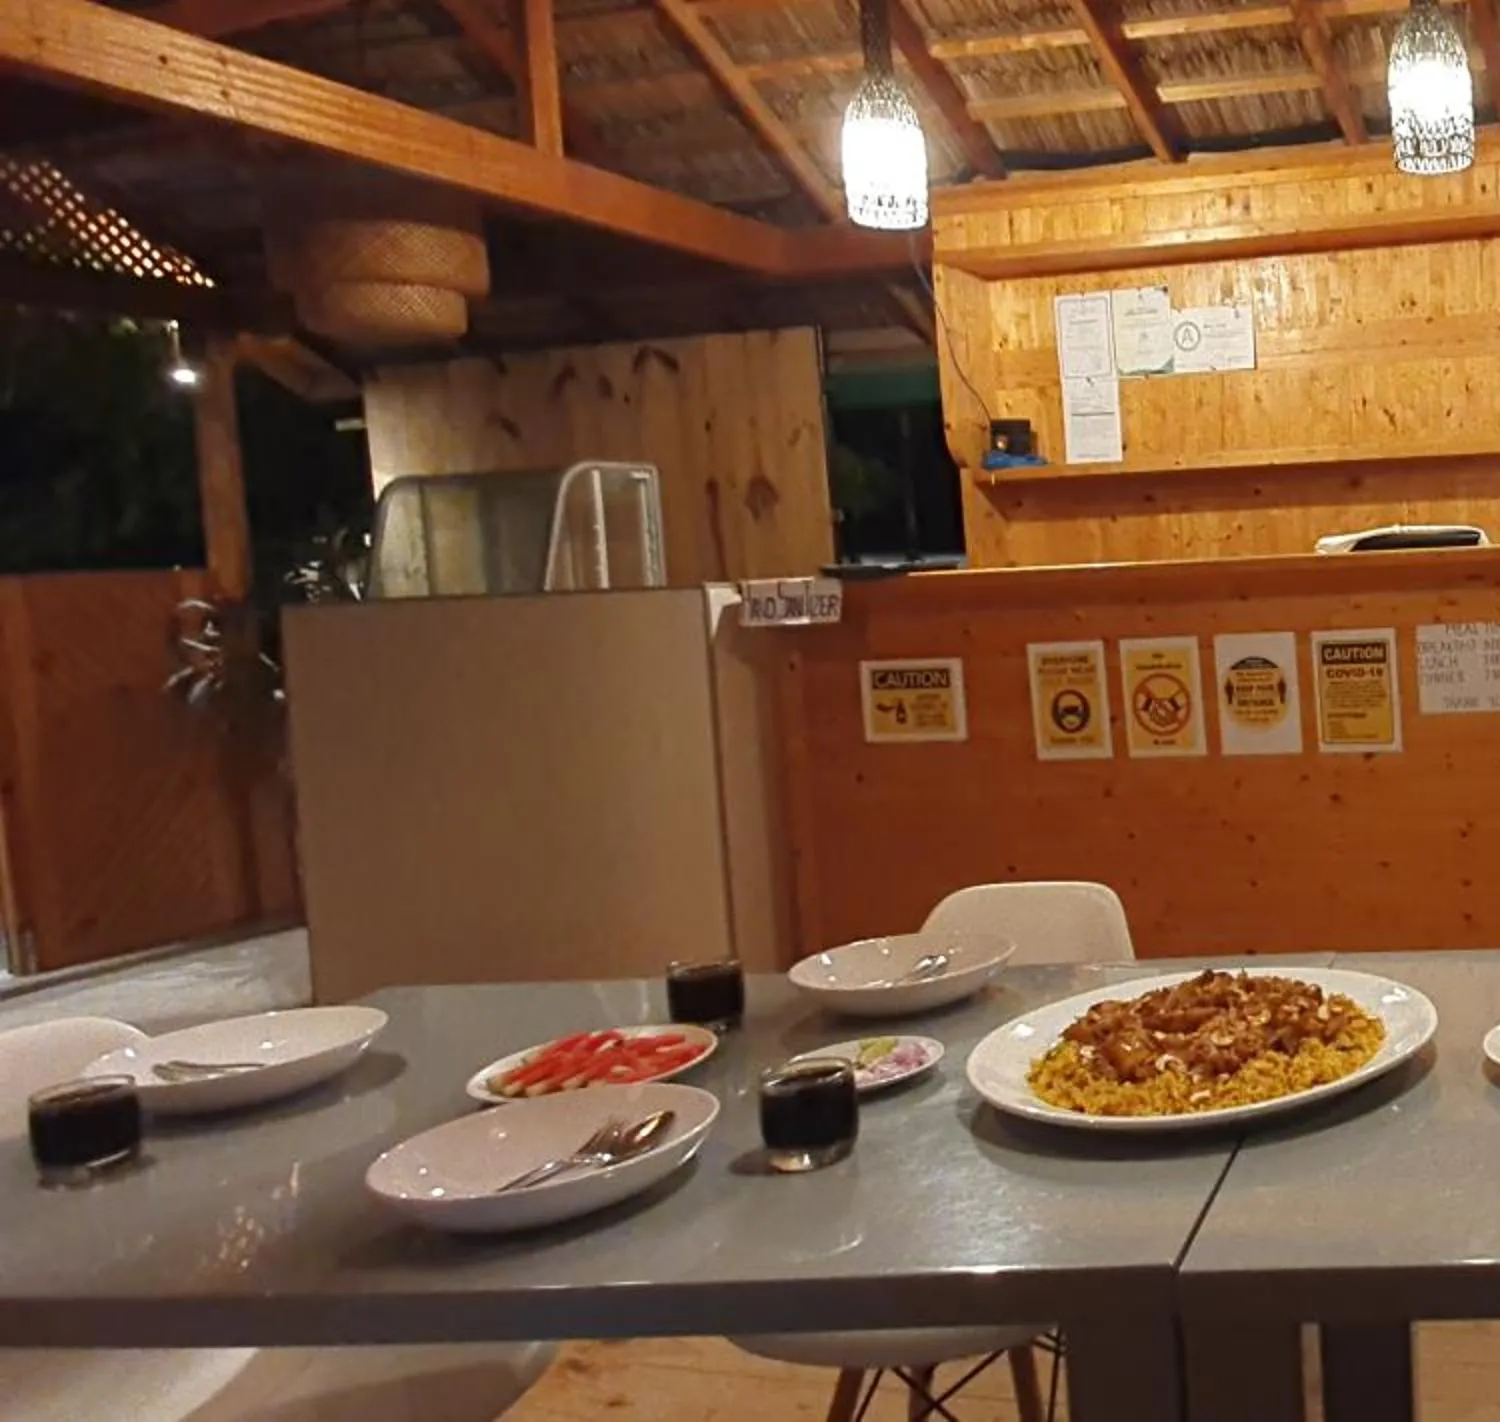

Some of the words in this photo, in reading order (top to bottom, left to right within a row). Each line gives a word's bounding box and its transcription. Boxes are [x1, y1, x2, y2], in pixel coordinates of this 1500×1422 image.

[1323, 645, 1385, 661] CAUTION
[875, 670, 948, 689] CAUTION
[1326, 667, 1384, 678] COVID-19
